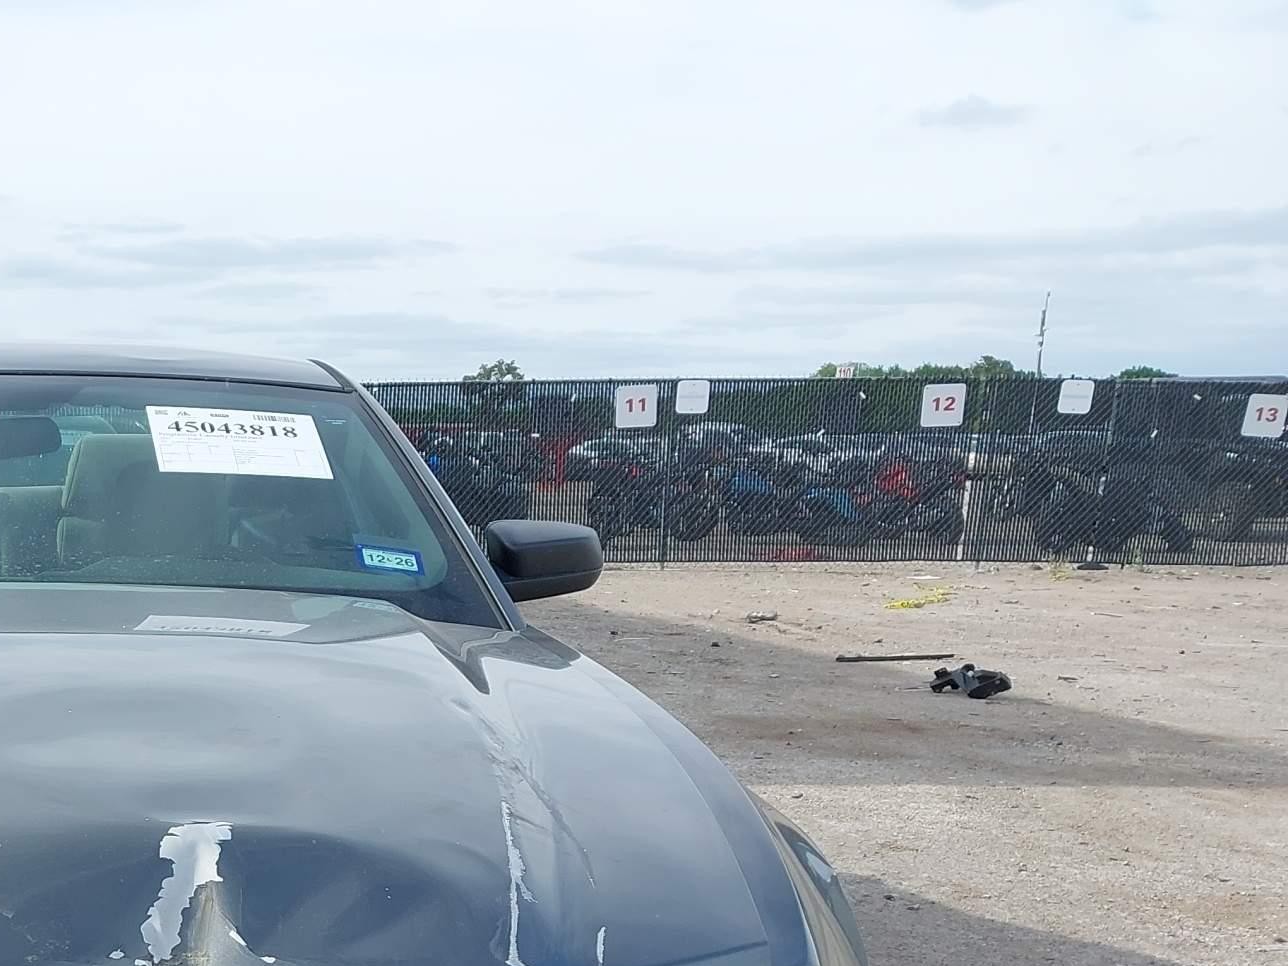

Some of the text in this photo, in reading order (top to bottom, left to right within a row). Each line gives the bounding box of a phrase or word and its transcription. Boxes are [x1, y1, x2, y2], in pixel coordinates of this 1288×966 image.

[625, 397, 647, 413] 11
[932, 396, 956, 412] 12
[1255, 406, 1279, 423] 13
[167, 420, 298, 439] 45043818
